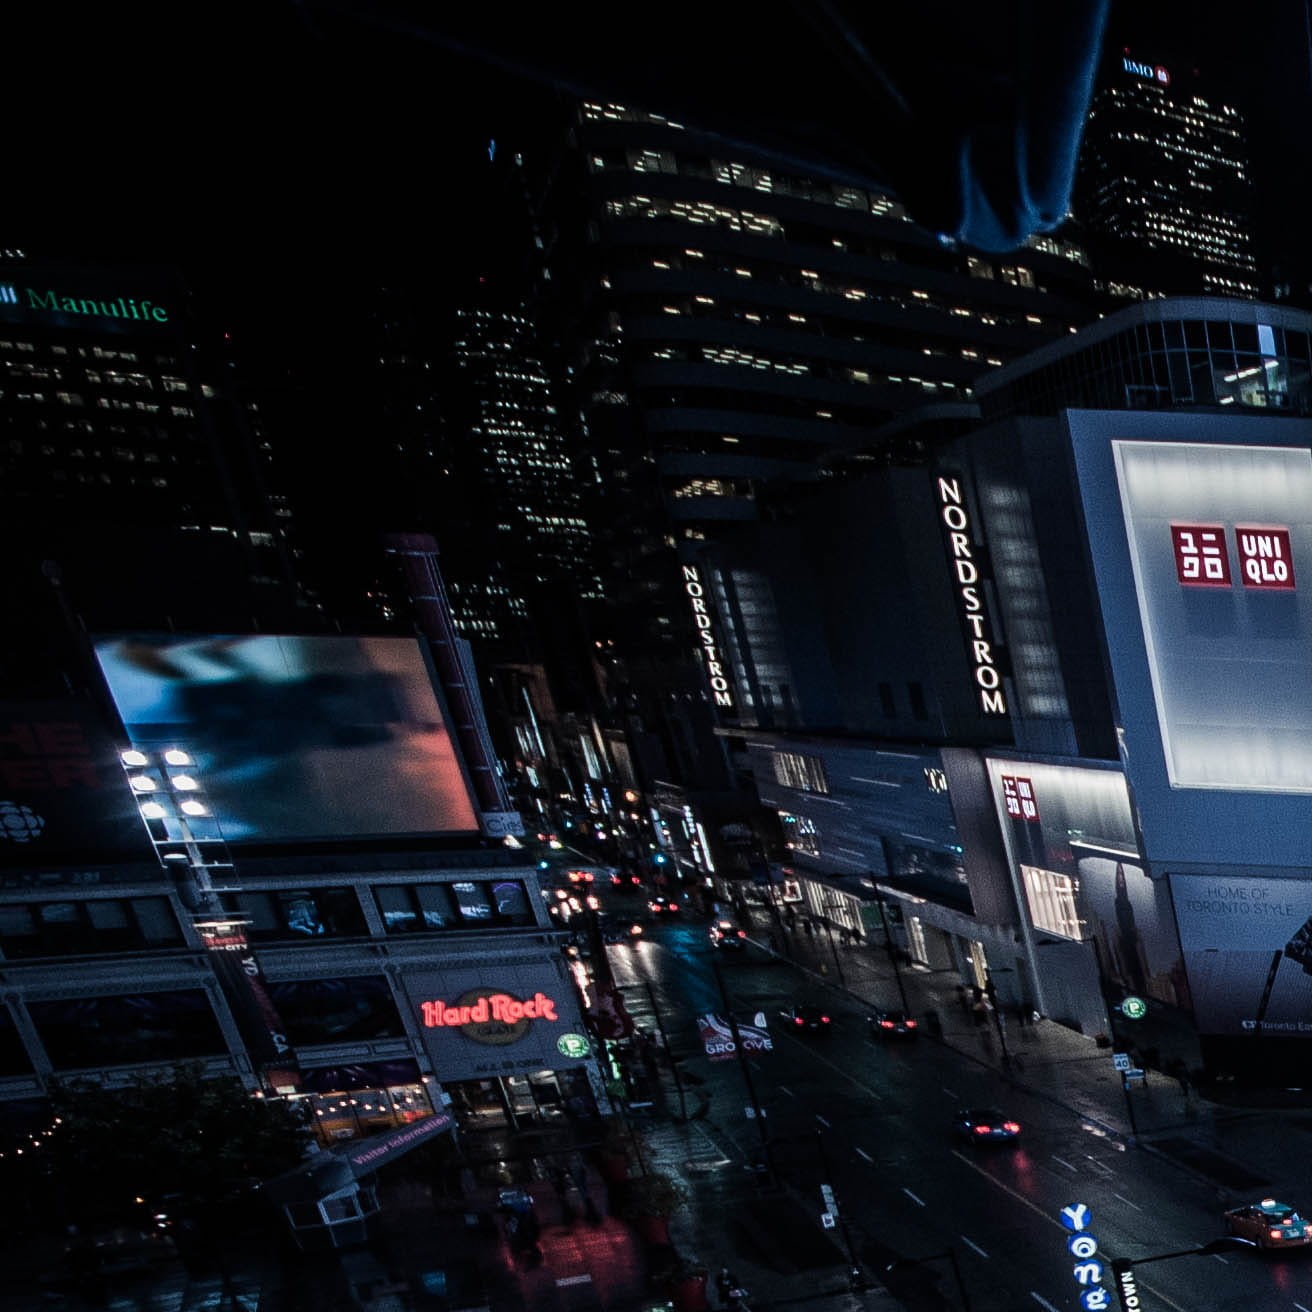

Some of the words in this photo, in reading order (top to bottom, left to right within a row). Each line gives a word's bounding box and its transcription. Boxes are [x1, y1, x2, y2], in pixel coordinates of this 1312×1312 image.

[24, 287, 169, 323] Manulife
[1241, 534, 1282, 558] UNI
[1245, 558, 1288, 584] QLO
[937, 476, 1006, 716] NORDSTROM
[681, 564, 733, 708] NORDSTROM
[1207, 887, 1248, 899] HOME
[1251, 888, 1270, 899] OF
[1253, 904, 1296, 917] STYLE
[421, 997, 490, 1028] Hard
[488, 992, 559, 1025] Rock
[1259, 1020, 1297, 1032] Toronto
